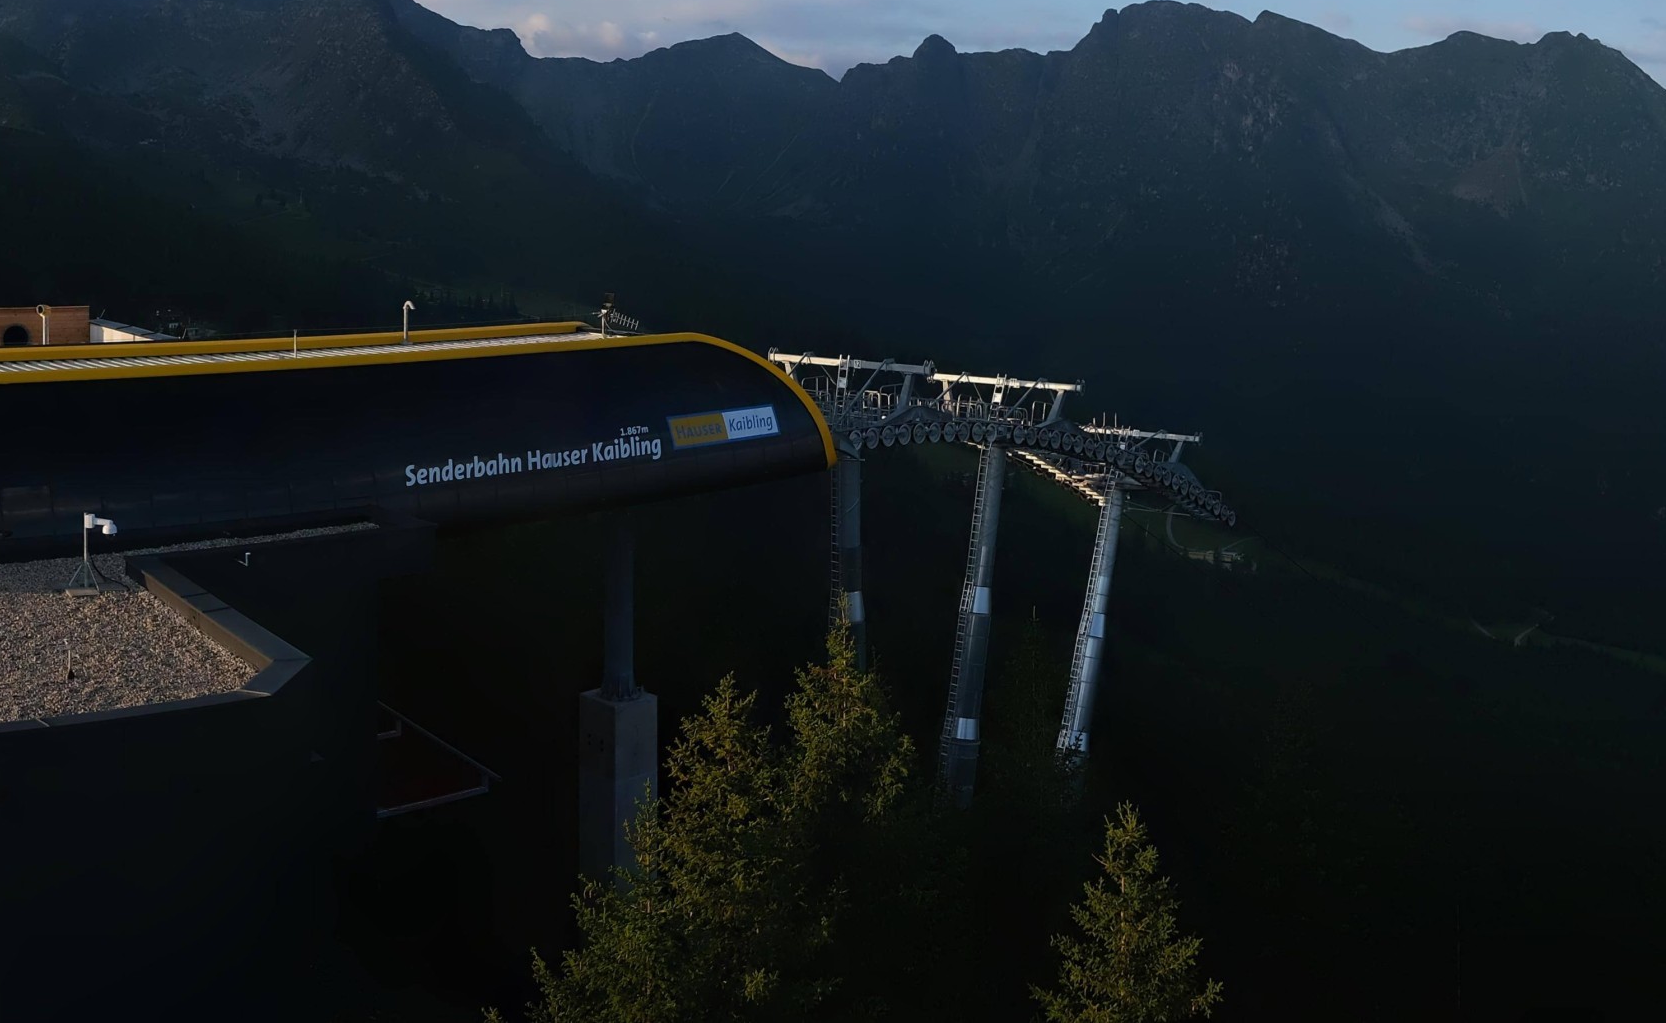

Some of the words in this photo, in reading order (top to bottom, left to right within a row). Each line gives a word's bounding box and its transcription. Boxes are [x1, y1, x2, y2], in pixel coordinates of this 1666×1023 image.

[676, 424, 722, 439] HAUSER
[728, 415, 773, 432] Kaibling
[405, 453, 522, 487] Senderbahn
[527, 448, 588, 470] Hauser
[592, 436, 662, 462] Kaibling
